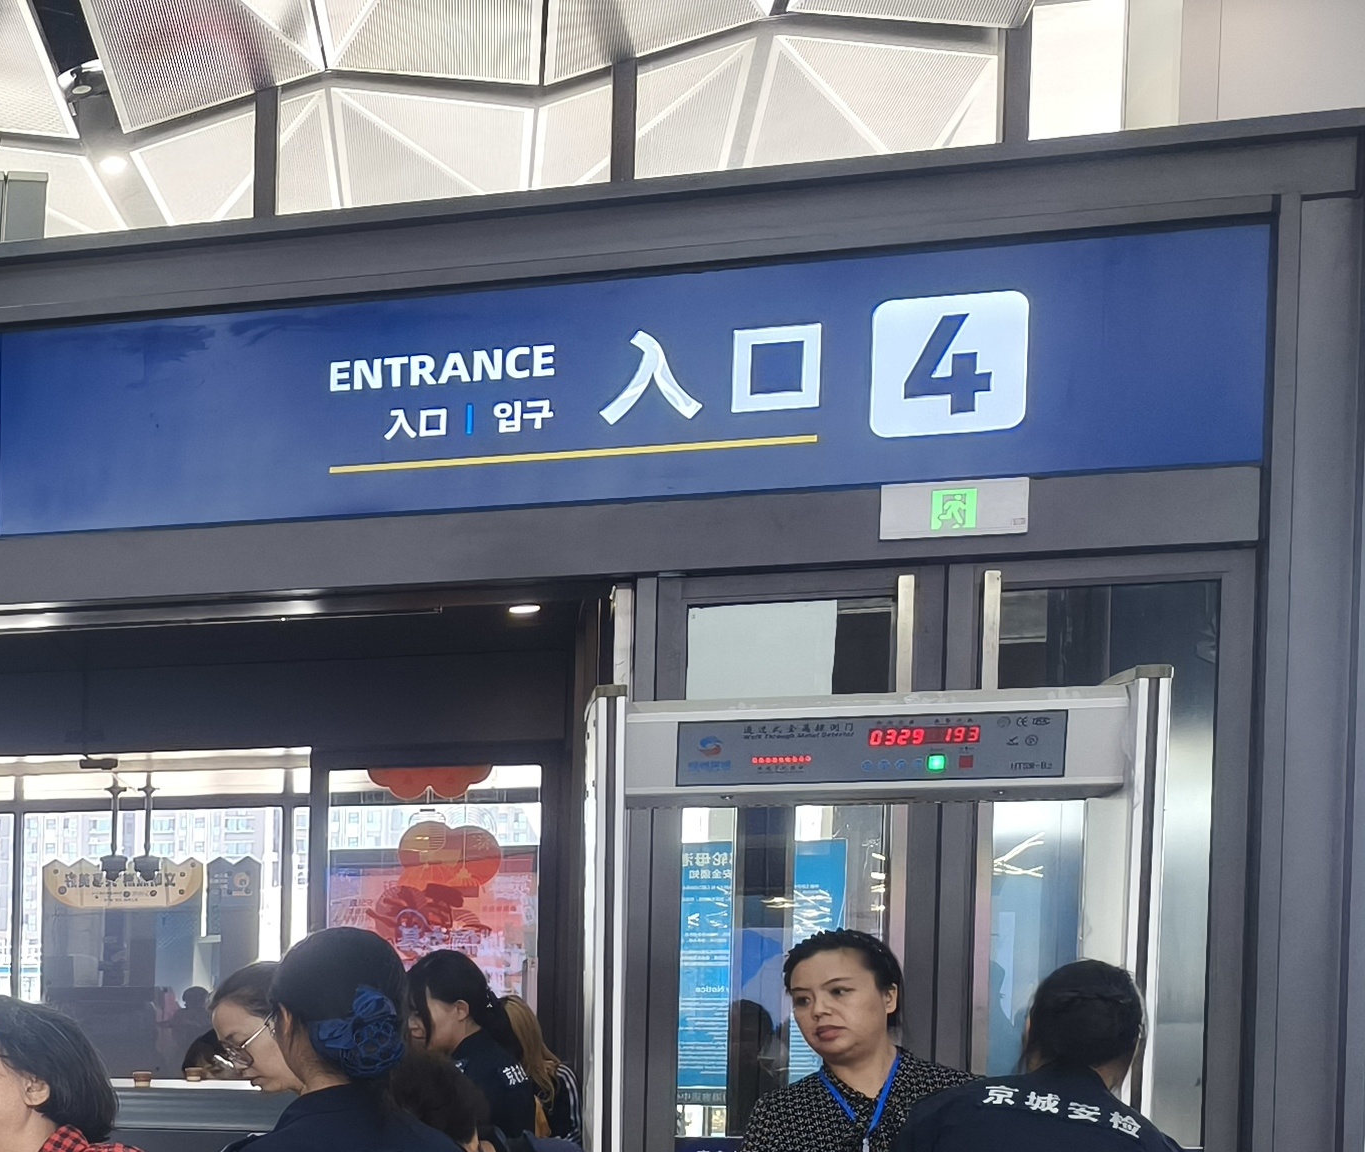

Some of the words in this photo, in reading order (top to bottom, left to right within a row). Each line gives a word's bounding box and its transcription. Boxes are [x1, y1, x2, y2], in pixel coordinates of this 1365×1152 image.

[329, 344, 556, 392] ENTRANCE
[599, 322, 822, 425] 入口
[903, 313, 994, 415] 4
[383, 406, 447, 440] 入口
[493, 399, 555, 435] 입구
[869, 728, 925, 747] 0329
[945, 726, 980, 743] 193
[983, 1084, 1142, 1140] 京城安检
